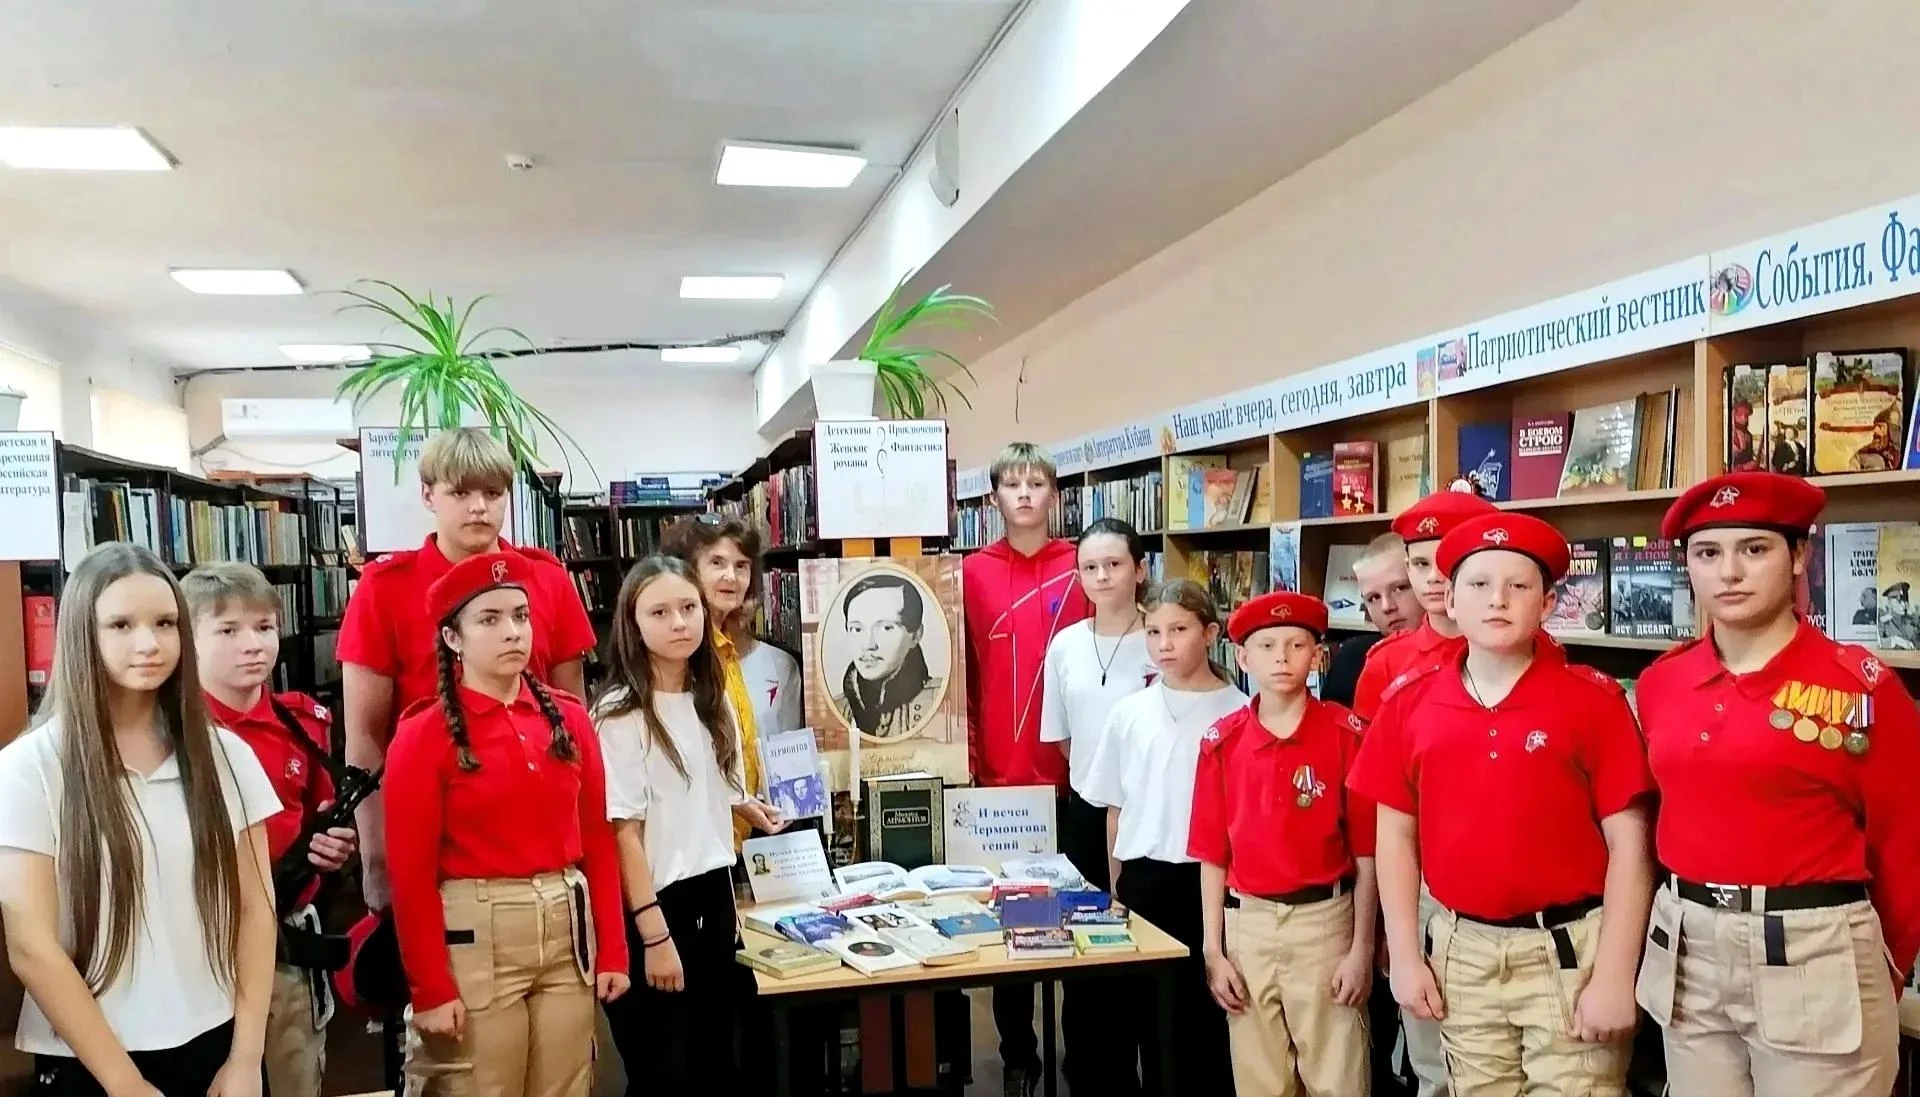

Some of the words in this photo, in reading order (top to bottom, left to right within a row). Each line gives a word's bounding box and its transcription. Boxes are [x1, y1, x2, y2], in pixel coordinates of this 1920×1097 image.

[1755, 241, 1873, 310] События.
[1882, 211, 1920, 284] Фа
[1467, 295, 1612, 371] Патриотический
[1616, 279, 1705, 333] вестник
[1172, 412, 1199, 440] Наш
[1201, 400, 1234, 437] край:
[1236, 397, 1277, 428] вчера,
[1281, 379, 1342, 415] сегодня,
[1347, 360, 1407, 399] завтра
[824, 425, 871, 437] Детективы
[888, 424, 943, 437] Приключения
[368, 432, 424, 445] Зарубеная
[1519, 435, 1563, 447] СТРОЮ
[830, 443, 868, 454] Женские
[890, 442, 943, 452] Фантастика
[833, 459, 868, 471] романы
[1567, 559, 1598, 576] ОСКВУ
[1615, 625, 1632, 634] ИСТ
[1637, 623, 1672, 636] ДЕСАНТ
[770, 743, 808, 758] ЛЕРМОНТОВ
[979, 808, 988, 818] И
[993, 808, 1029, 818] вечен
[969, 824, 1047, 837] Лермонтова
[983, 840, 1019, 851] гений
